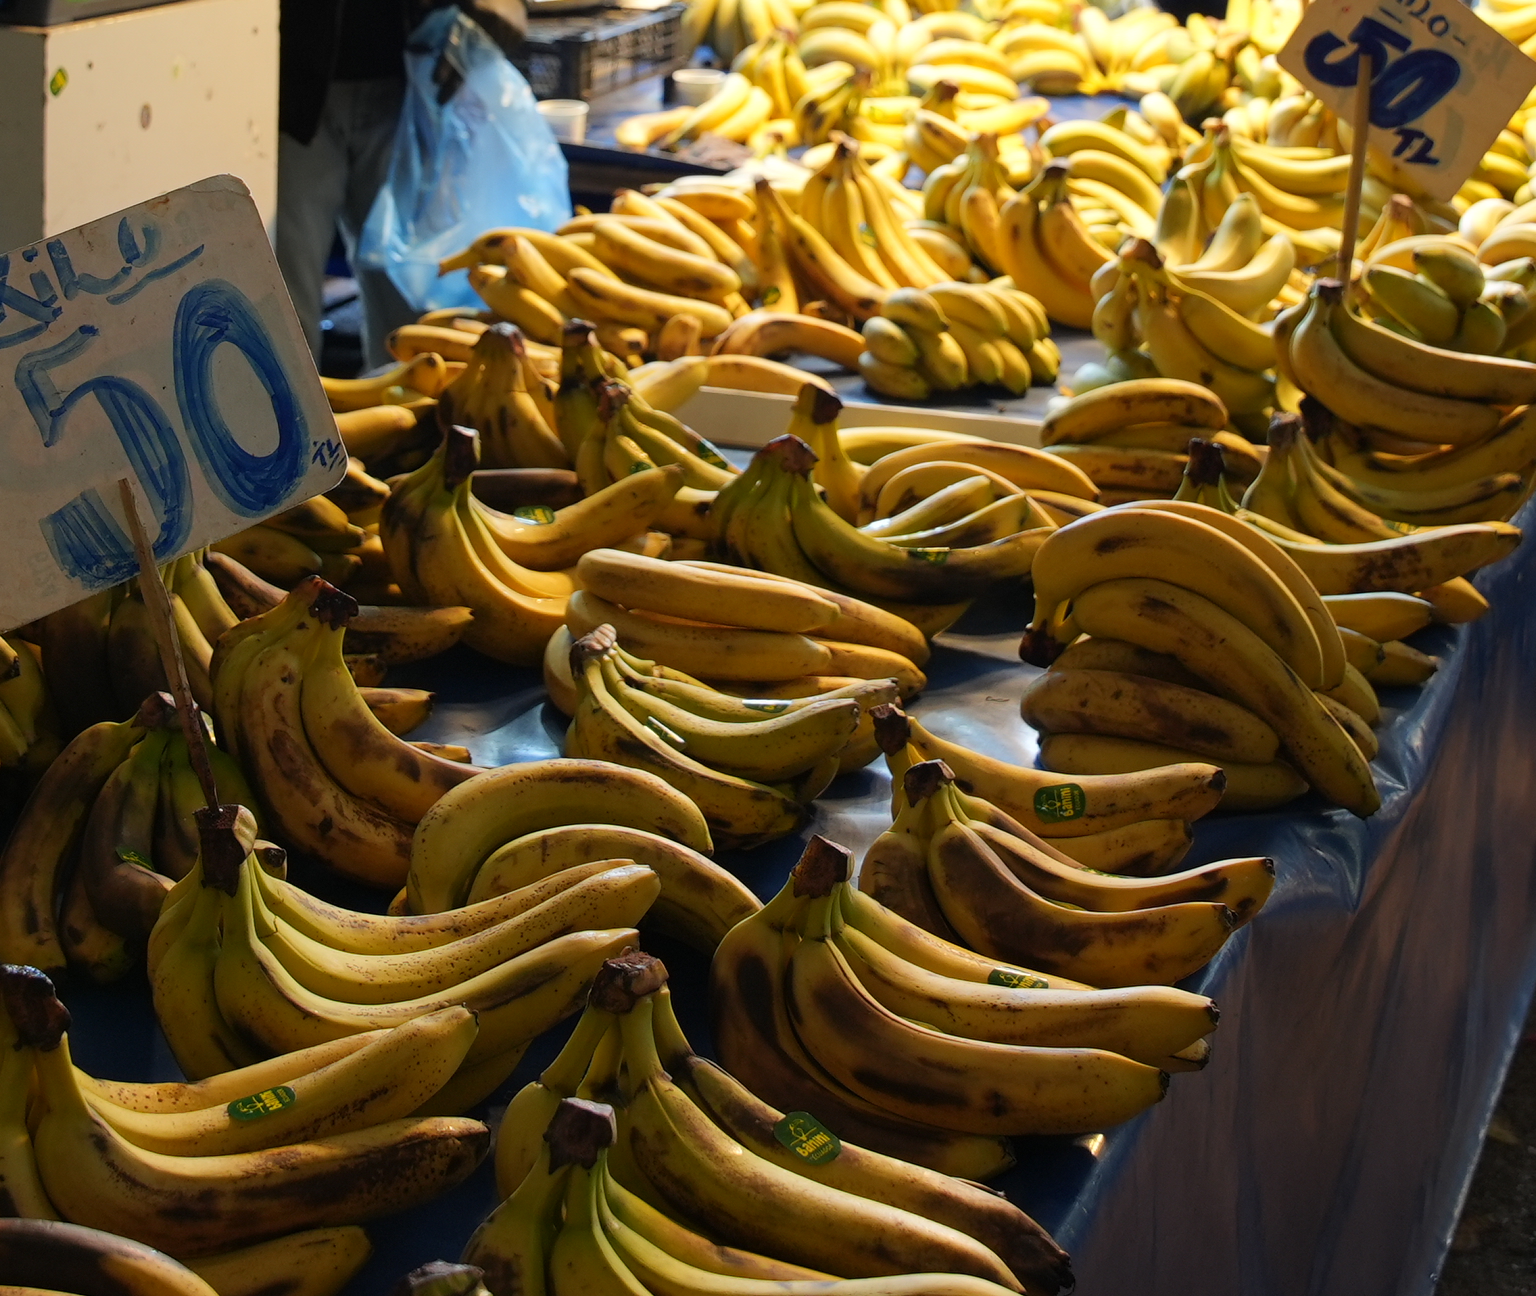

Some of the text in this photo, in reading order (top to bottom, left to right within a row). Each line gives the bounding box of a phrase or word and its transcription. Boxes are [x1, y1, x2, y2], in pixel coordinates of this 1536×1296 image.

[1303, 16, 1461, 130] 50
[13, 278, 311, 592] 50
[795, 1131, 832, 1158] Banini
